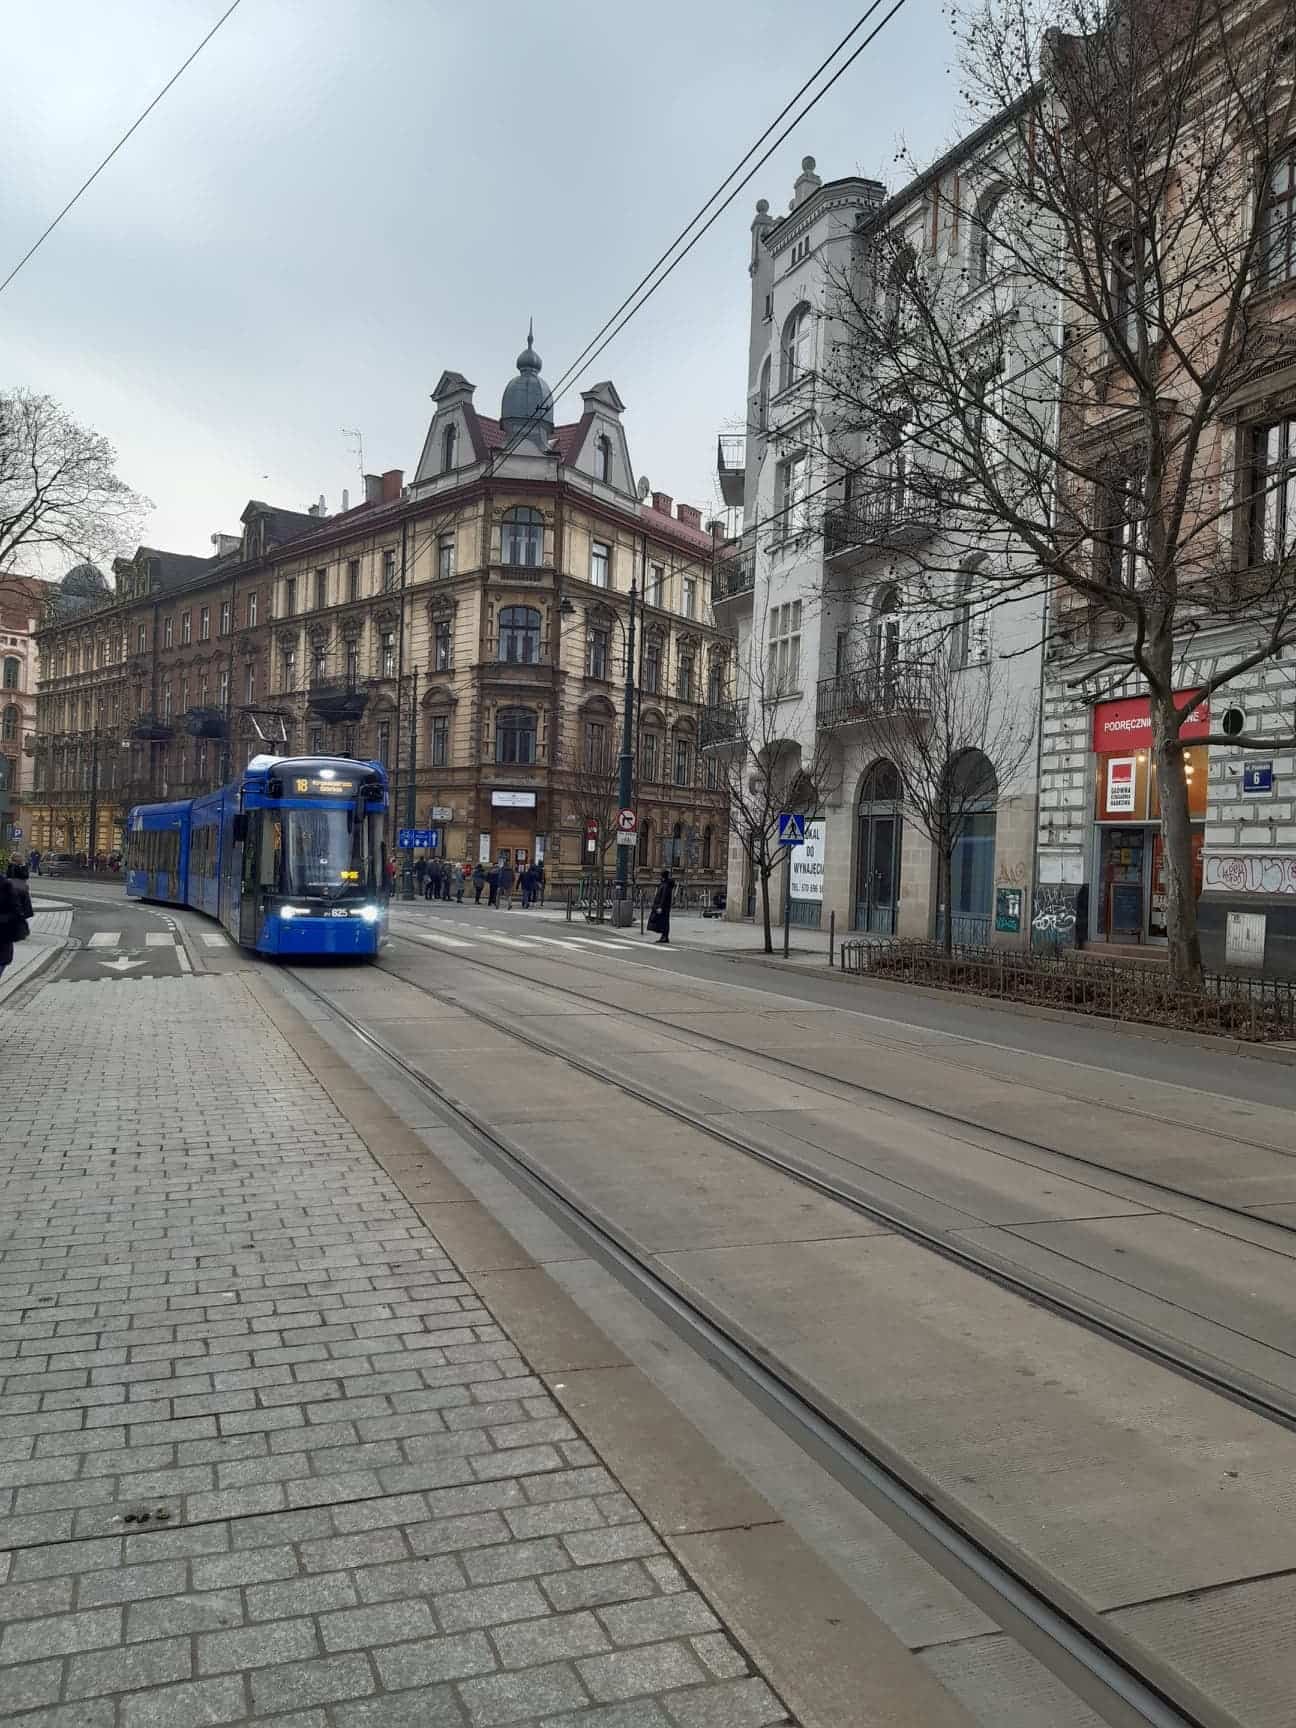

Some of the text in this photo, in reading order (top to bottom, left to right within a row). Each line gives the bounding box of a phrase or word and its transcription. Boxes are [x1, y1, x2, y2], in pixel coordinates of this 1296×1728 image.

[1253, 772, 1260, 785] 6
[296, 779, 308, 792] 18
[806, 846, 814, 857] DO
